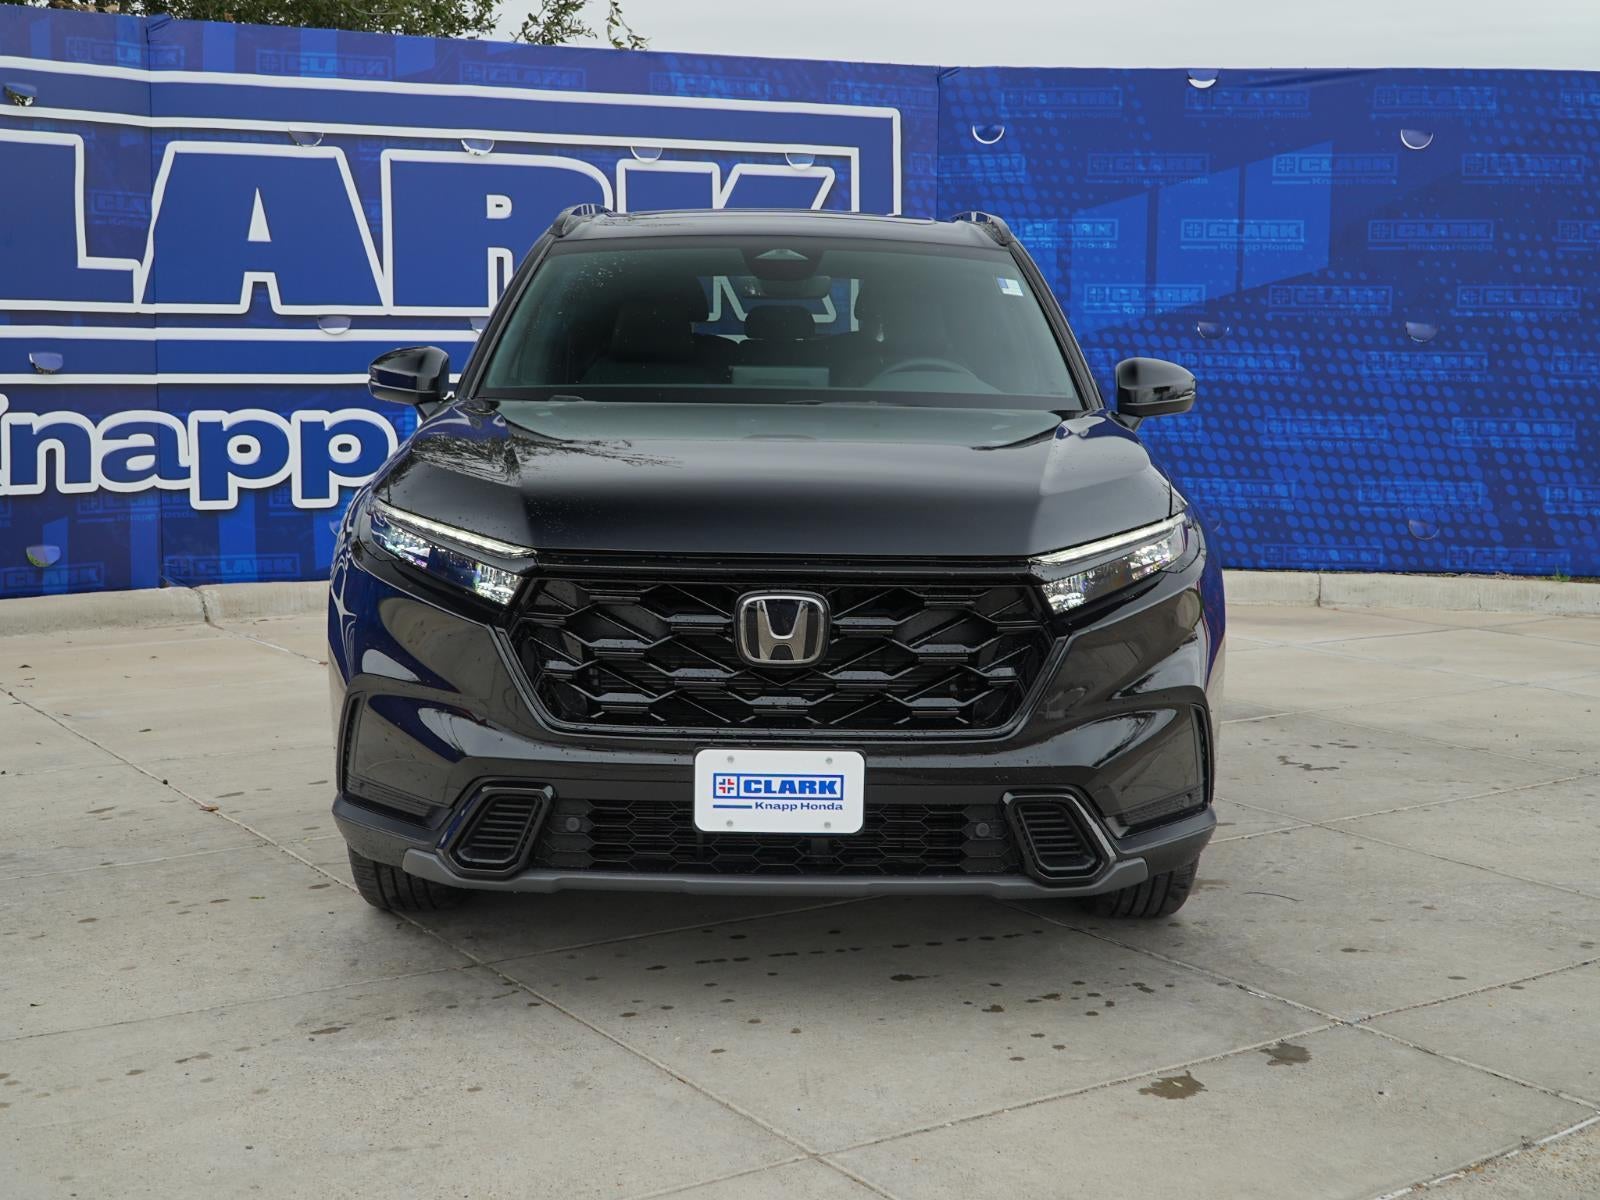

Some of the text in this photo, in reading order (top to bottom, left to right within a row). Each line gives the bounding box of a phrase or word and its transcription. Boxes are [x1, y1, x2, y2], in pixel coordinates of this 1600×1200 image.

[1301, 159, 1391, 171] CLARK
[1209, 223, 1298, 237] CLARK
[1398, 224, 1487, 237] CLARK
[0, 399, 402, 510] napp
[744, 779, 838, 795] CLARK
[755, 802, 843, 812] Knapp Honda
